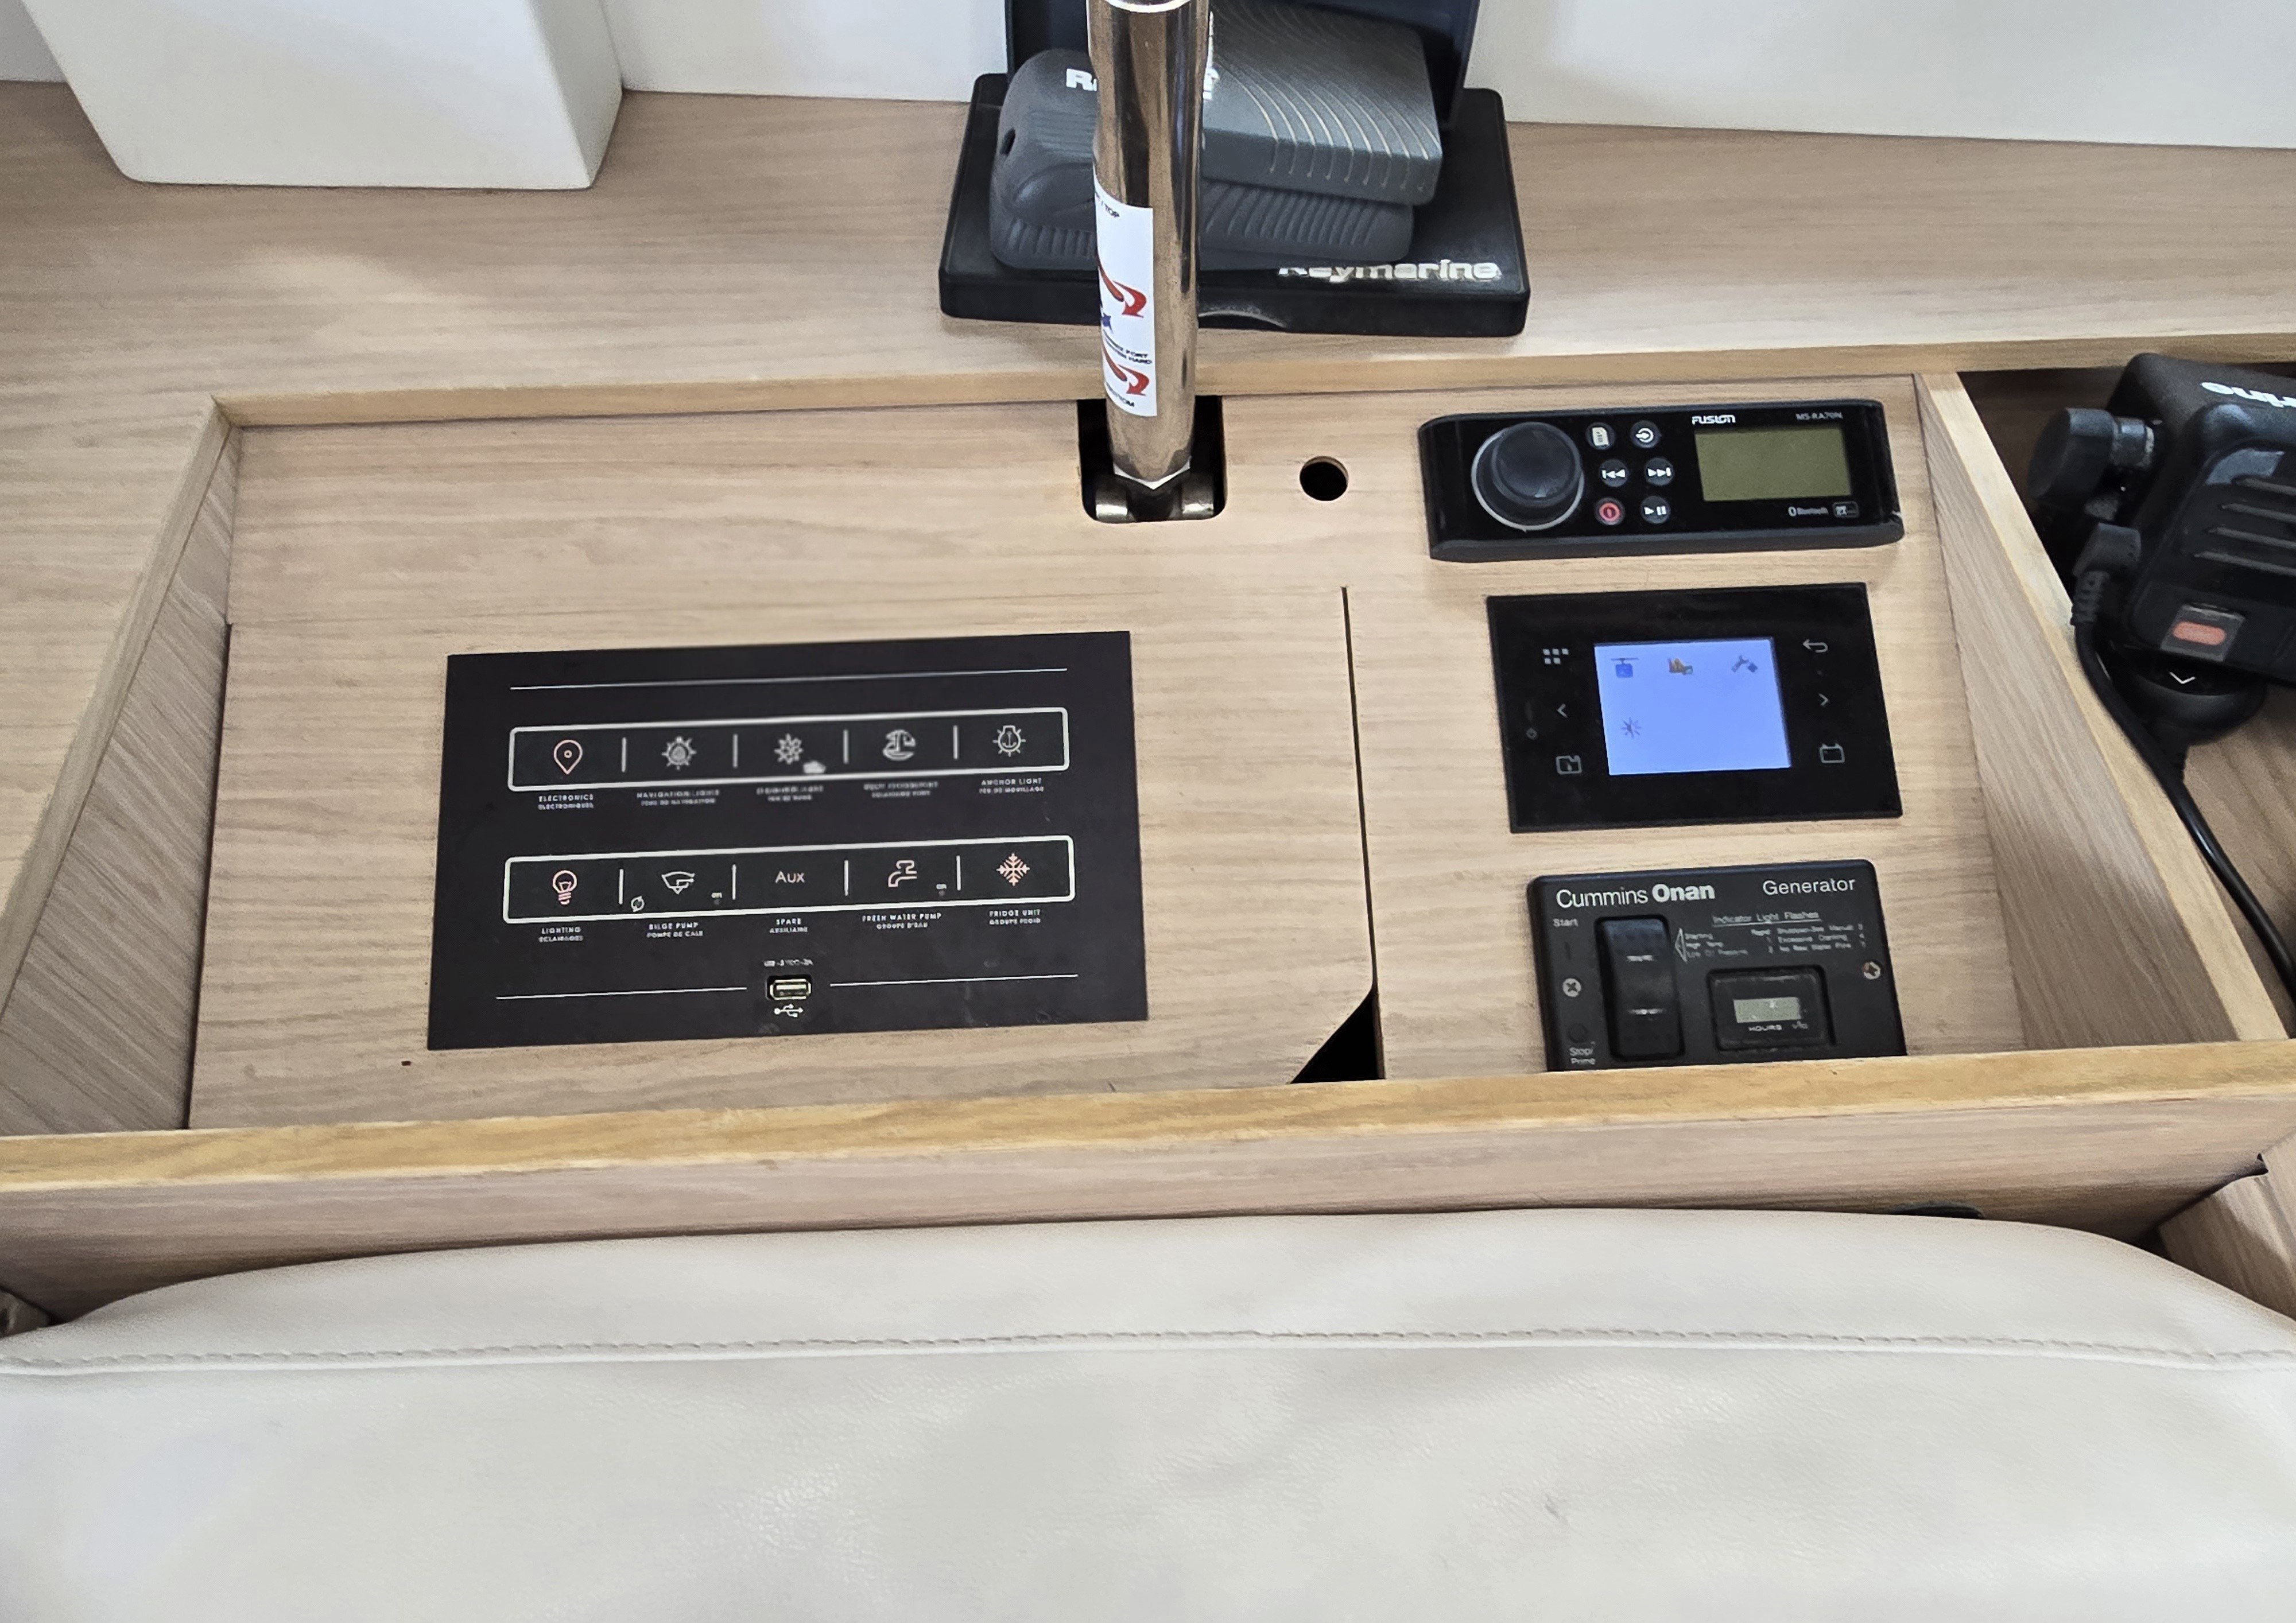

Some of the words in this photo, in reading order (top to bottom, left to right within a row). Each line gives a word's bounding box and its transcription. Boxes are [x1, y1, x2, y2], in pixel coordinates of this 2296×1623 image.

[538, 794, 594, 802] ELECTRONICS
[1762, 877, 1856, 895] Generator
[1556, 887, 1649, 908] Cummins
[1651, 884, 1715, 904] Onan
[541, 926, 581, 934] LIGHTING
